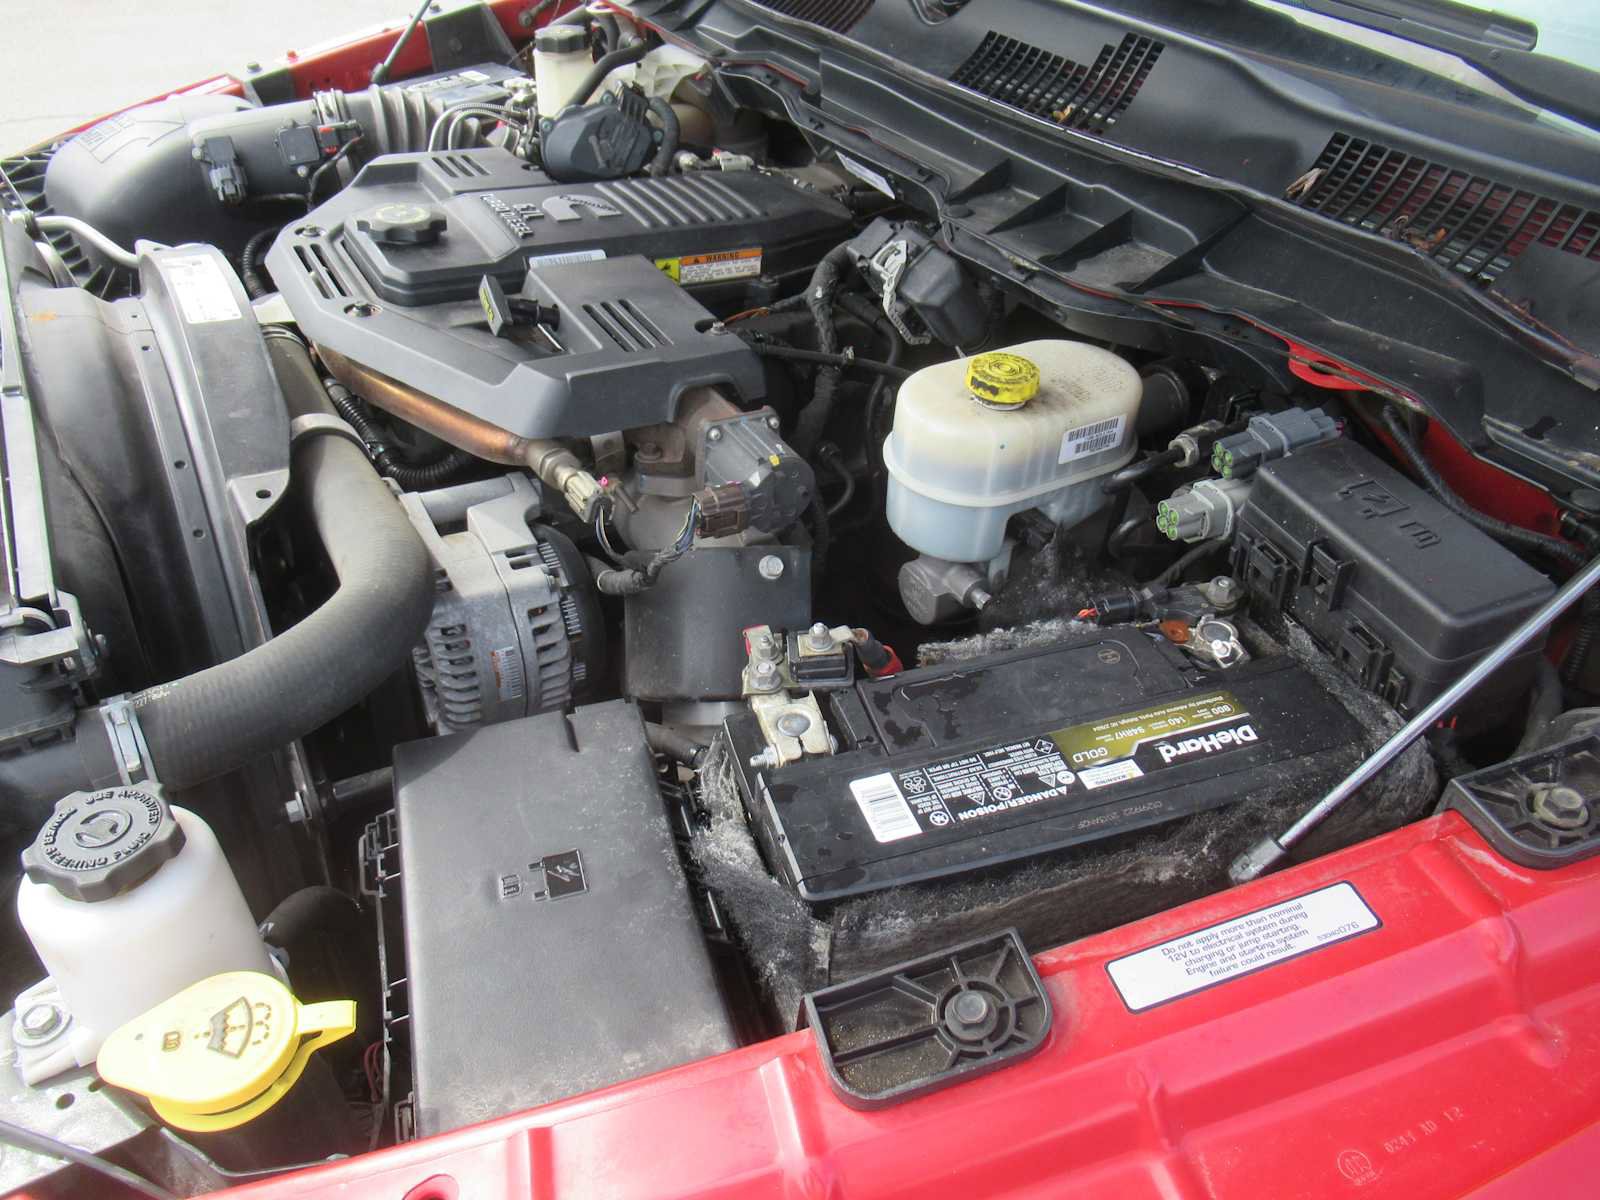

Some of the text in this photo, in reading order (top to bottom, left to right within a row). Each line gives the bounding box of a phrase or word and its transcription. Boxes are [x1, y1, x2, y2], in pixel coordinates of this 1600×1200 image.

[705, 252, 740, 262] WARNING
[1072, 746, 1108, 763] GOLD
[1158, 724, 1258, 763] DieHard
[85, 791, 115, 804] USE
[957, 788, 1061, 821] DANGER/POISON
[1161, 902, 1304, 957] Do not apply more than nominal
[1168, 911, 1309, 963] 12V to electrical system during
[1184, 948, 1226, 967] charging
[1226, 944, 1236, 953] or
[1238, 936, 1261, 950] jump
[1185, 928, 1309, 976] Engine and starting system
[1209, 962, 1239, 977] failure
[1241, 952, 1265, 966] could
